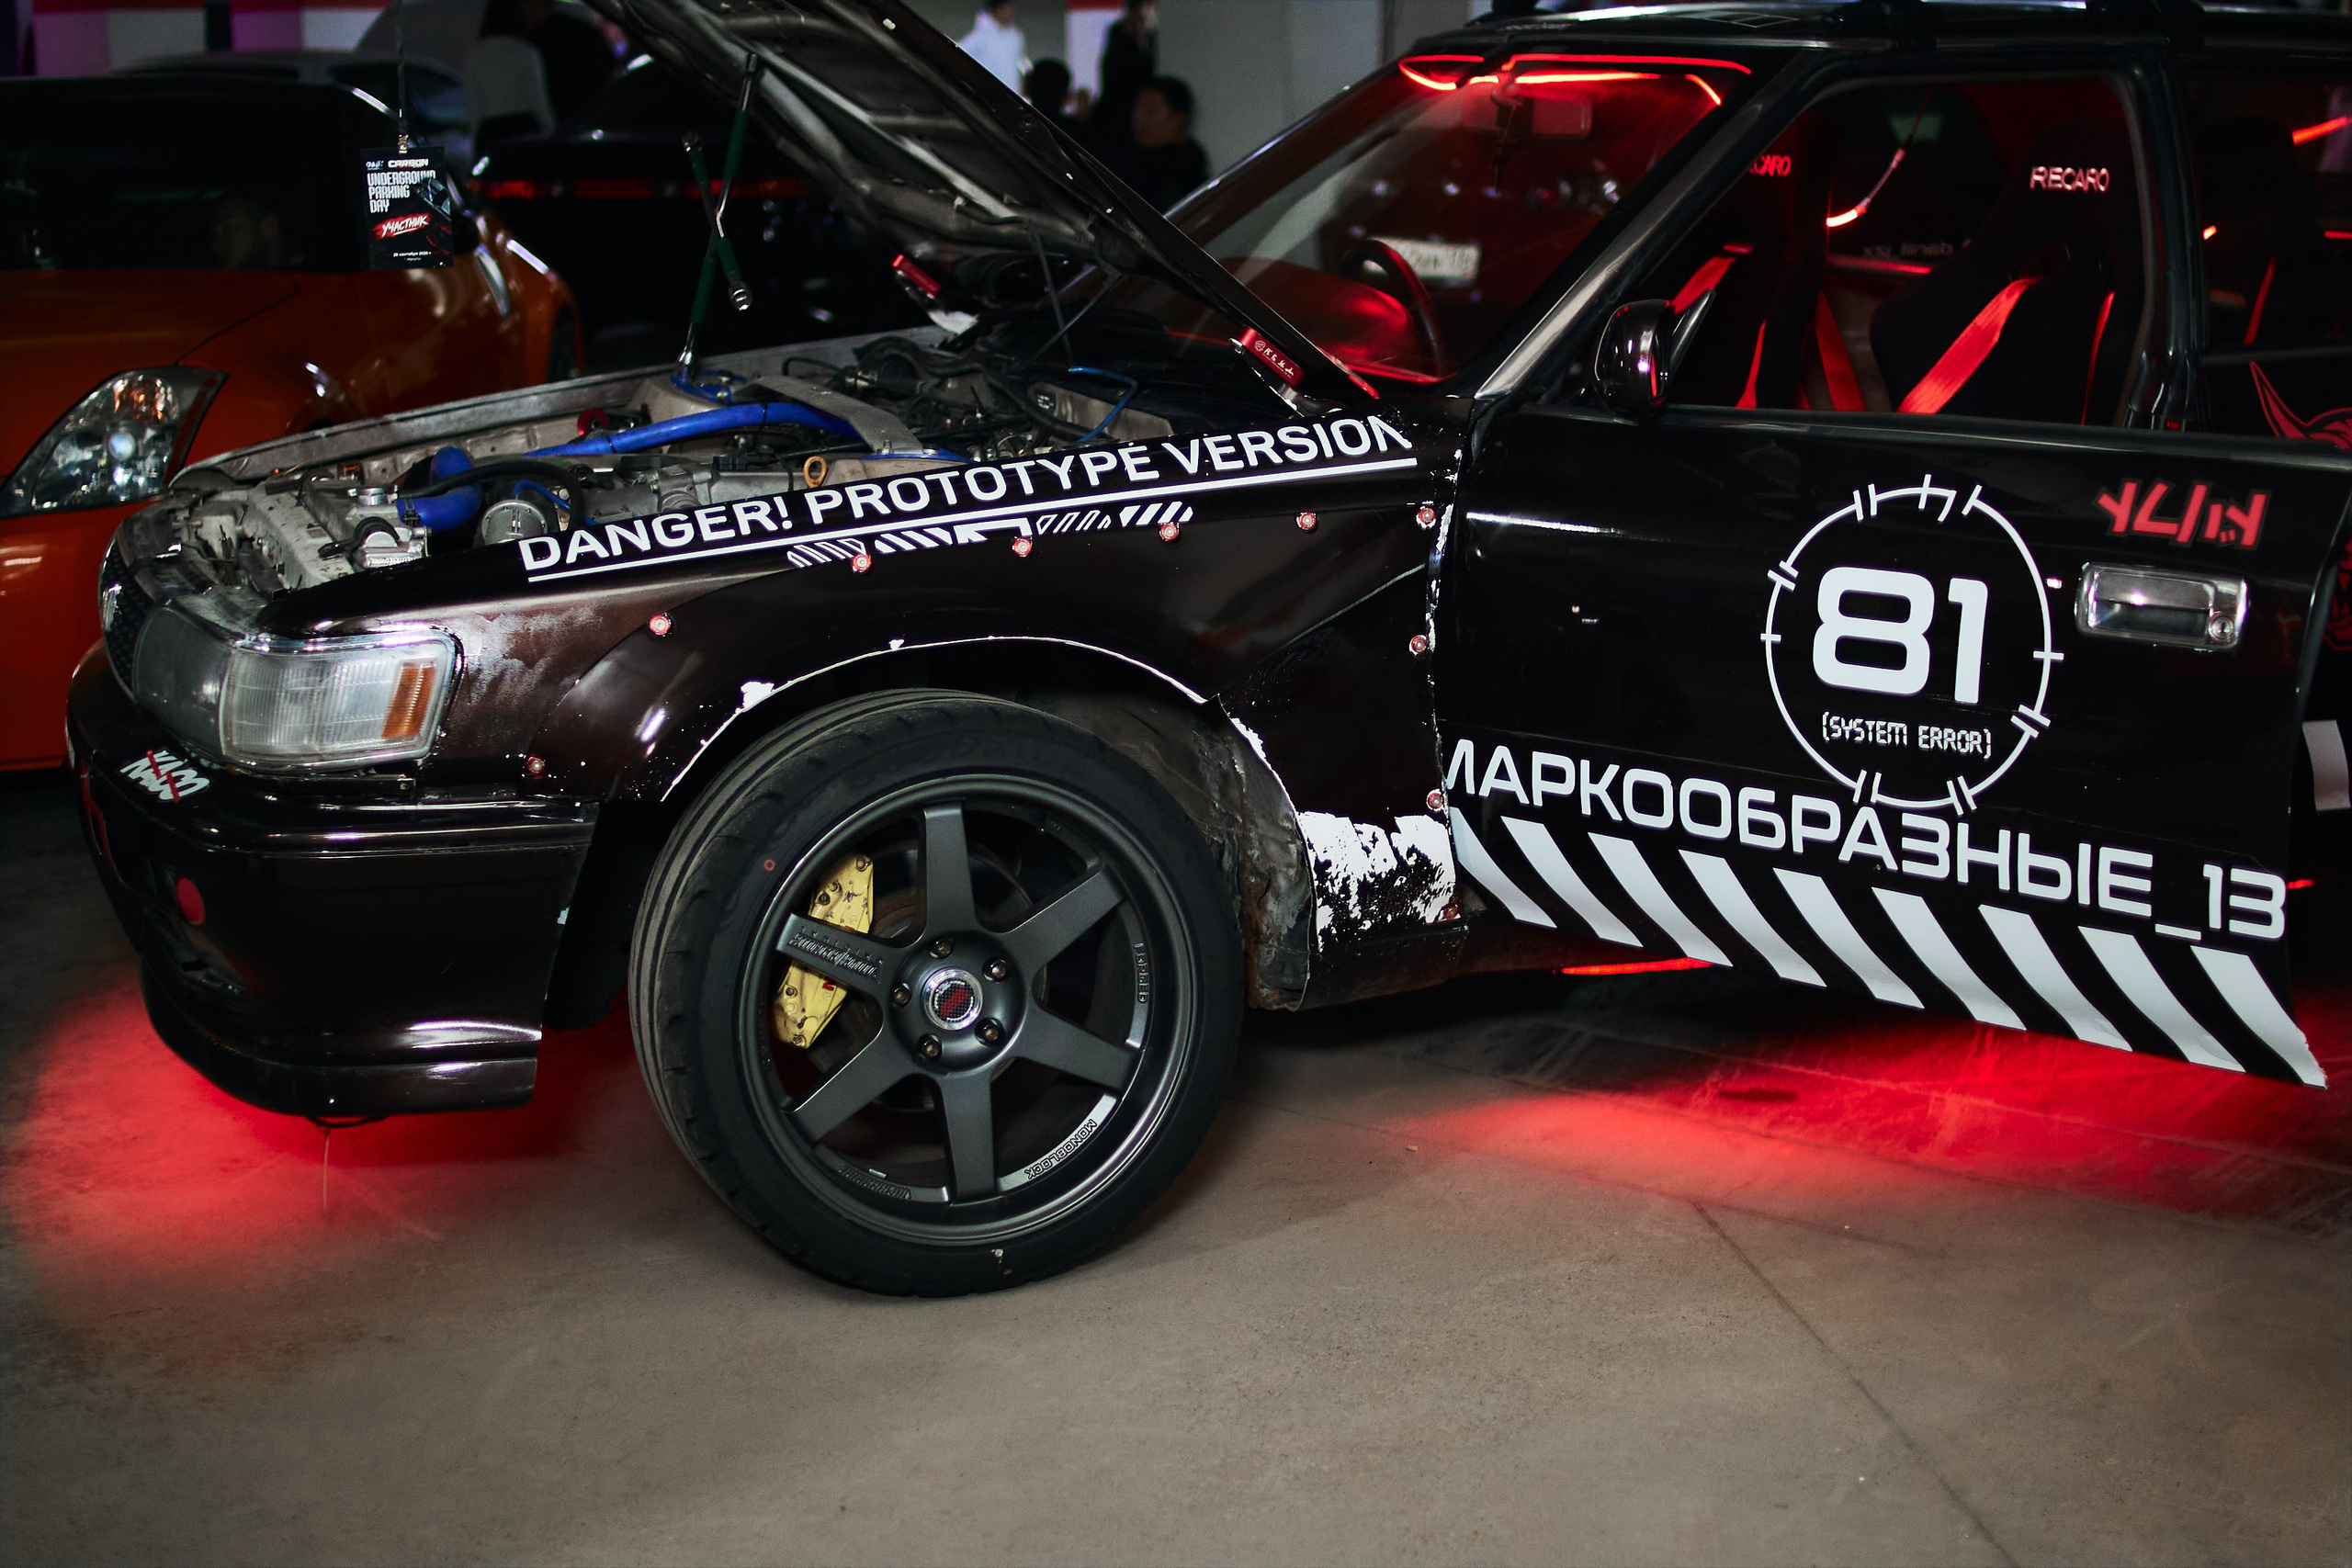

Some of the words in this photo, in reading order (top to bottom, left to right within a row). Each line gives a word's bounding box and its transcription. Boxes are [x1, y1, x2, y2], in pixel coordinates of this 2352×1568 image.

[367, 170, 436, 186] UNDERGROUND
[2030, 166, 2110, 192] RECARO
[368, 185, 411, 199] PARKING
[369, 198, 390, 213] DAY
[381, 215, 429, 239] УЧАСТНИК
[518, 496, 794, 571] DANGER!
[803, 445, 1160, 525] PROTOTYPE
[1161, 415, 1413, 475] VERSION
[1812, 566, 1989, 705] 81
[1132, 942, 1150, 1003] FORGED
[1023, 1118, 1099, 1180] MONOBLOCK
